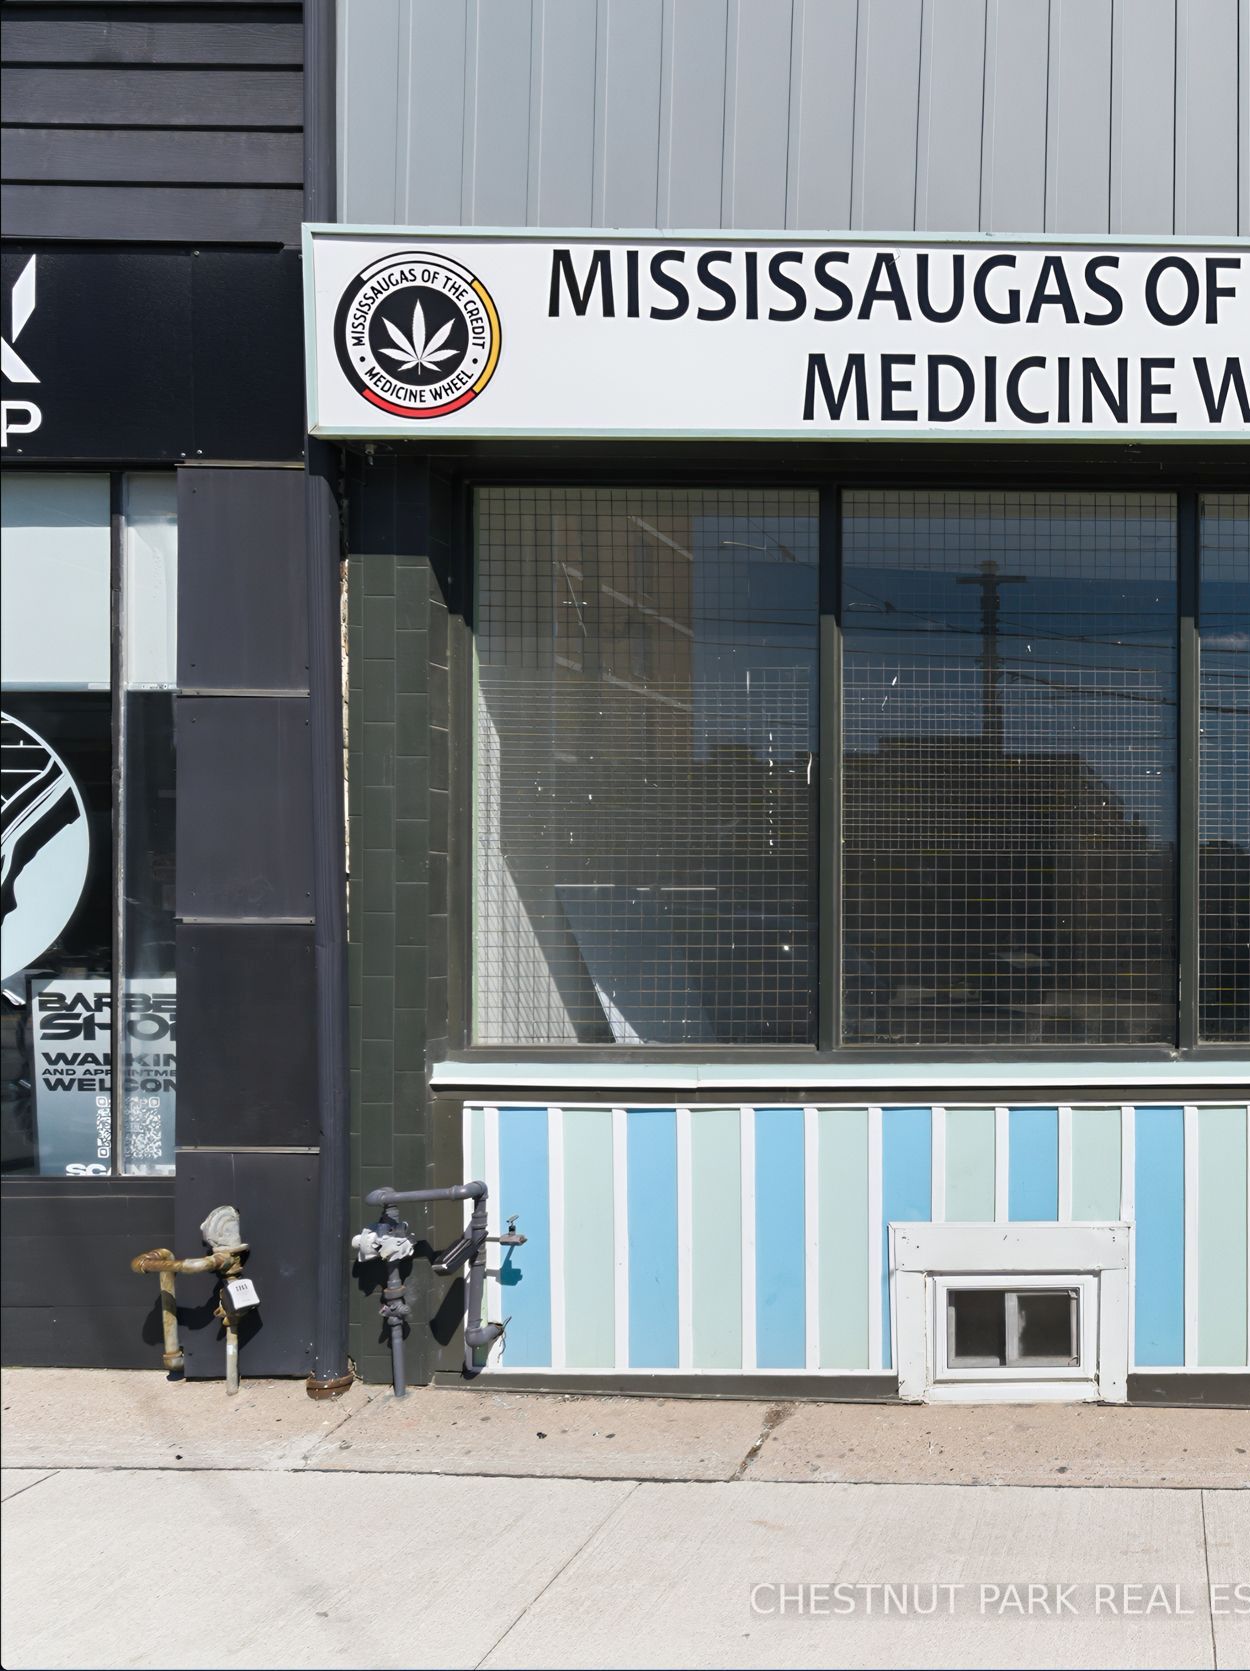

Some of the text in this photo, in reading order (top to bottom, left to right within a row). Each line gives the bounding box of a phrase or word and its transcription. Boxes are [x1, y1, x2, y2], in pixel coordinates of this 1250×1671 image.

[351, 268, 486, 350] MISSISSAUGAS OF THE CREDIT
[548, 249, 1123, 326] MISSISSAUGAS
[1145, 256, 1241, 327] OF
[364, 366, 474, 403] MEDICINE WHEEL
[802, 353, 1178, 424] MEDICINE
[42, 1068, 76, 1076] AND
